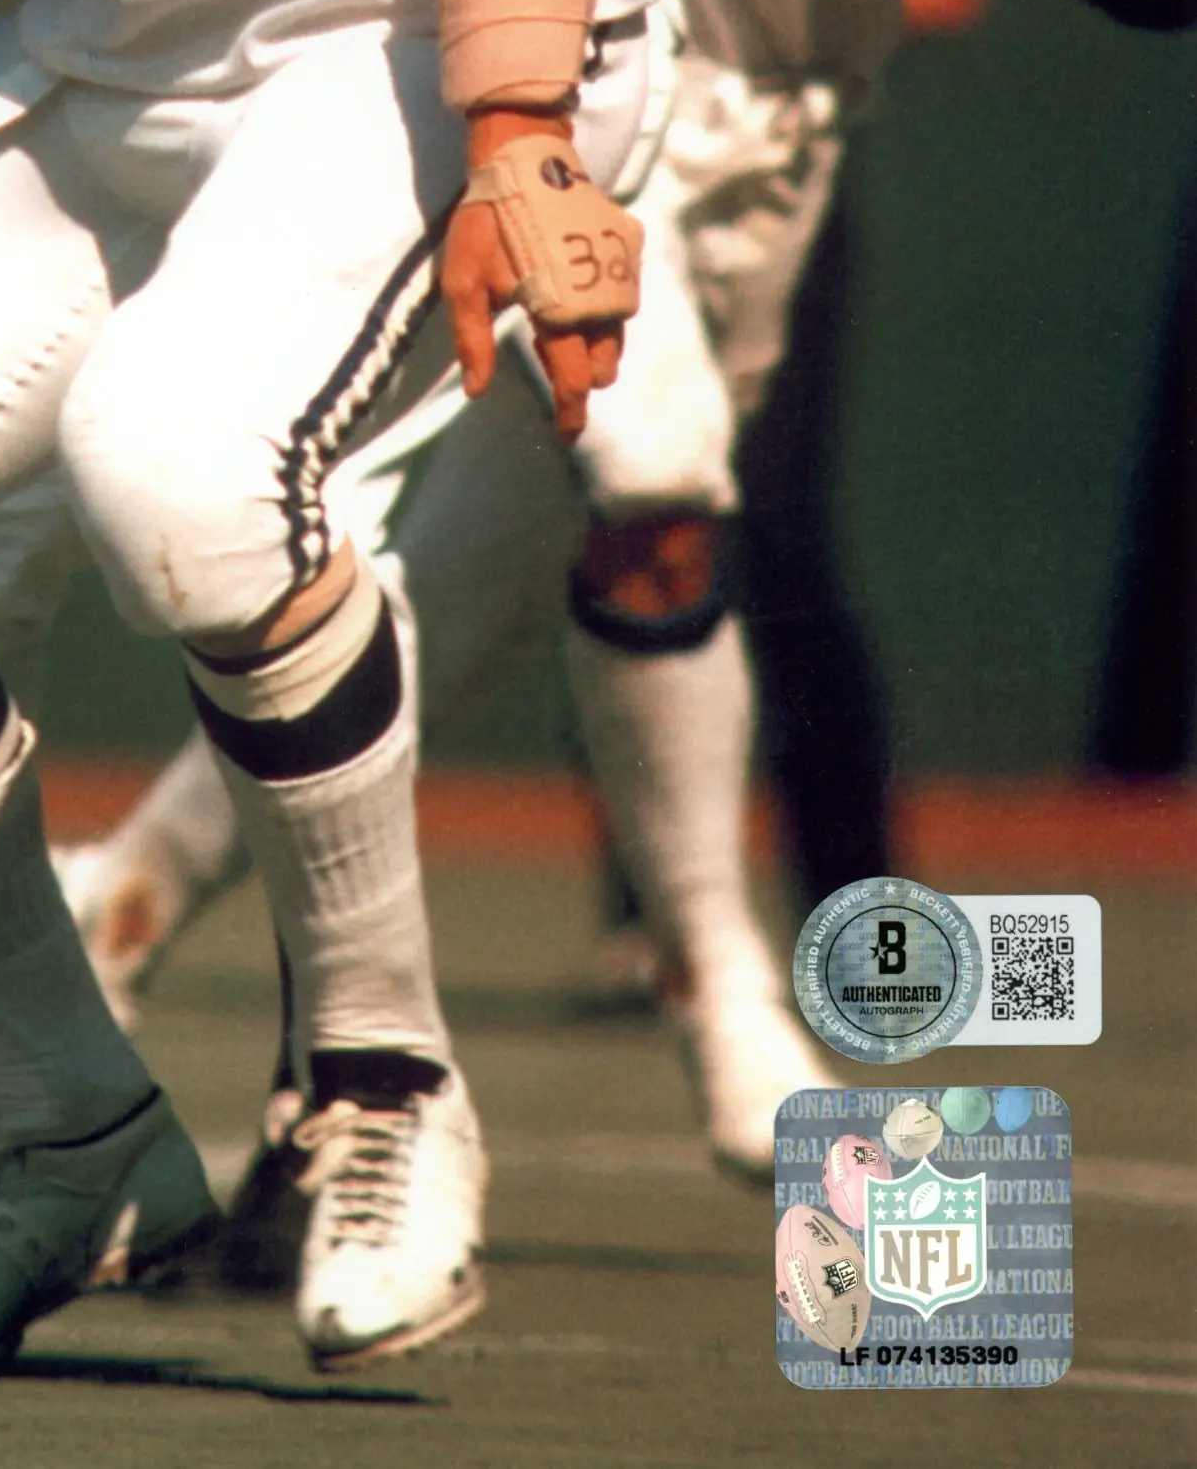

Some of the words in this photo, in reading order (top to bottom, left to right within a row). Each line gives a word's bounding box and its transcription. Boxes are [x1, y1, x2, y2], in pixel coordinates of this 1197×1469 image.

[813, 887, 871, 945] AUTHENTIC
[909, 887, 961, 929] BECKETT
[990, 914, 1070, 935] BQ52915
[807, 947, 824, 1010] VERIFIED
[955, 926, 973, 993] VERIFIED
[842, 985, 942, 1003] AUTHENTICATED
[859, 1005, 925, 1016] AUTOGRAPH
[819, 1010, 871, 1051] BECKETT
[910, 995, 968, 1051] AUTHENTIC
[934, 1134, 1047, 1162] NATIONAL
[880, 1229, 972, 1295] NFL
[840, 1346, 870, 1366] LF
[876, 1345, 1019, 1366] 074135390
